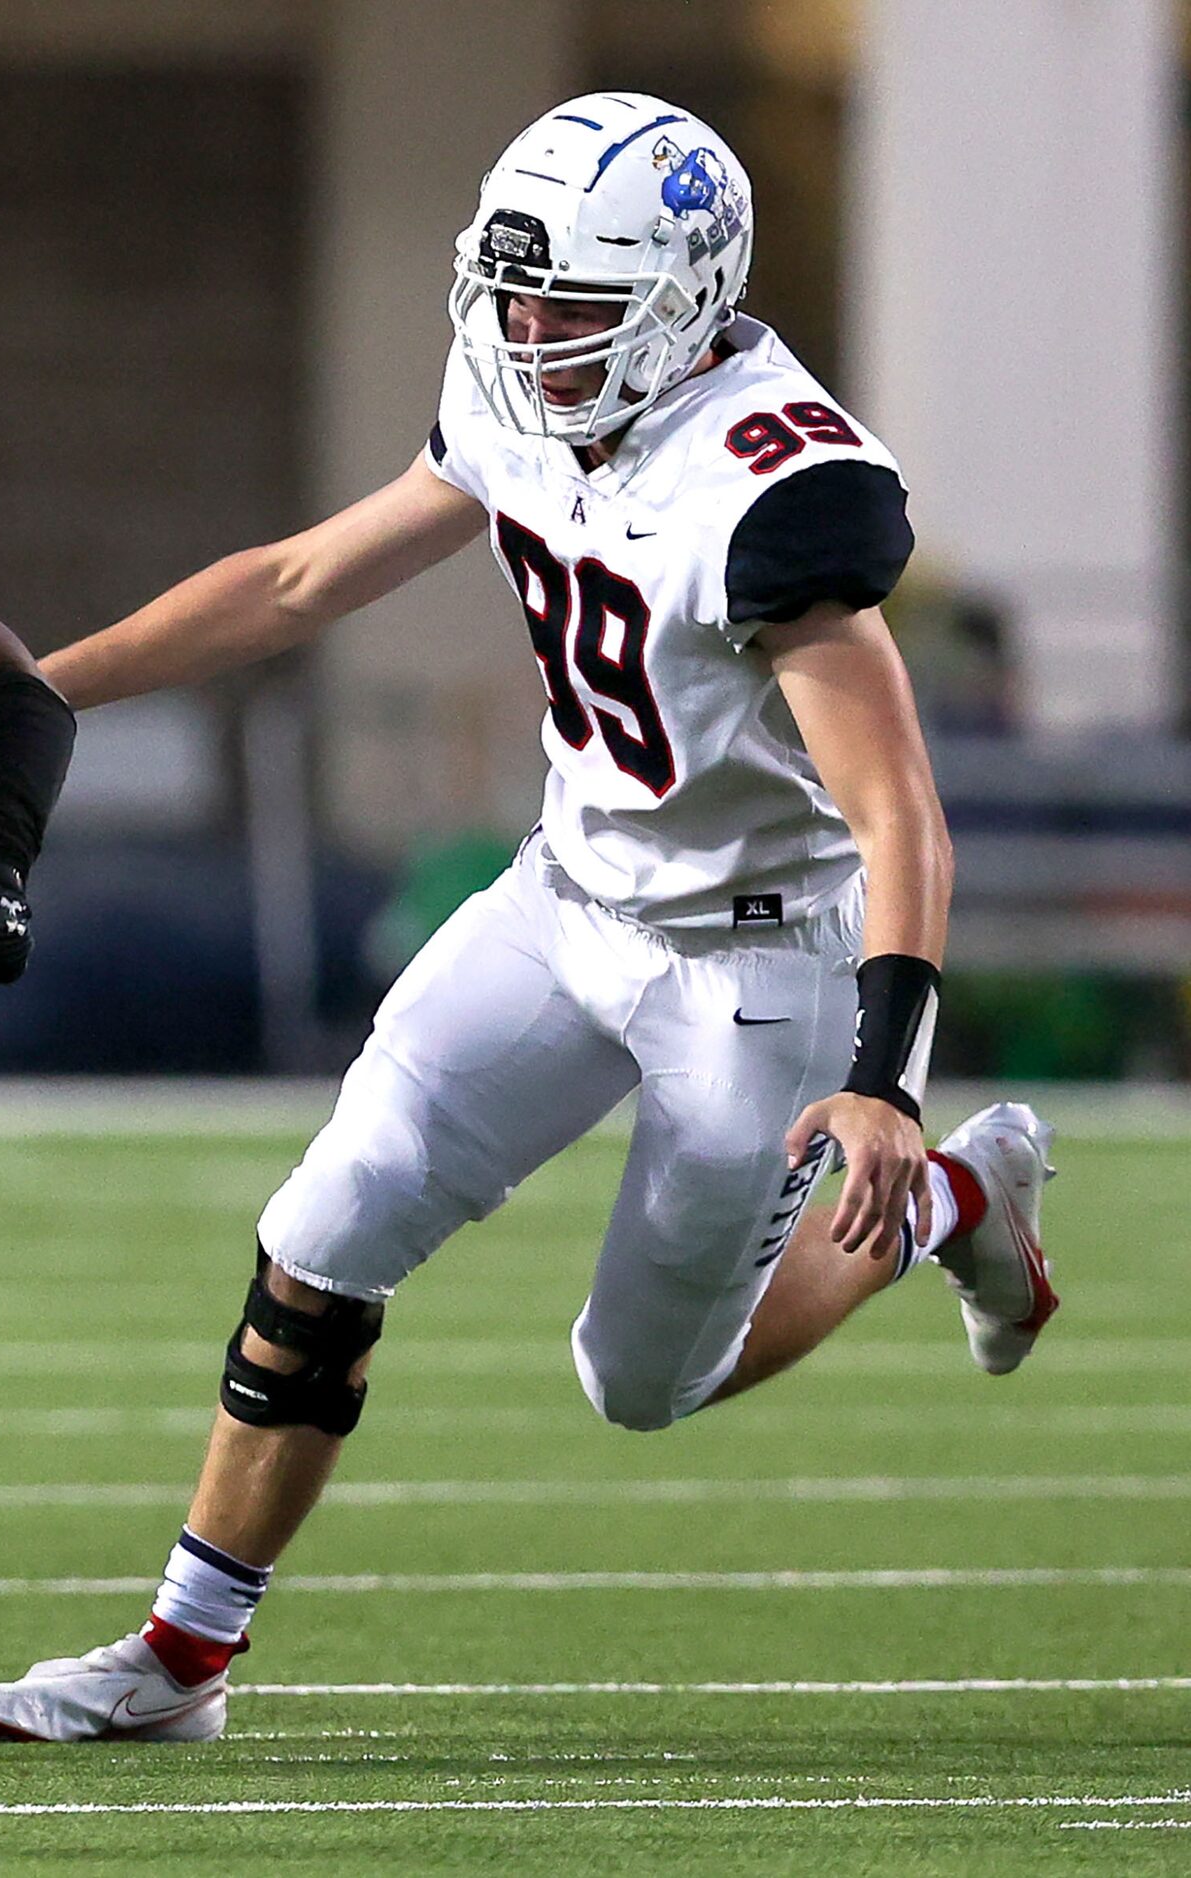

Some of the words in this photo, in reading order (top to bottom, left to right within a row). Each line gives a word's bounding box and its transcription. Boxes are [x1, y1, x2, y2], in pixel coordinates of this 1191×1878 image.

[724, 401, 863, 475] 99
[570, 495, 586, 526] A
[496, 510, 676, 800] 99
[746, 900, 770, 916] XL
